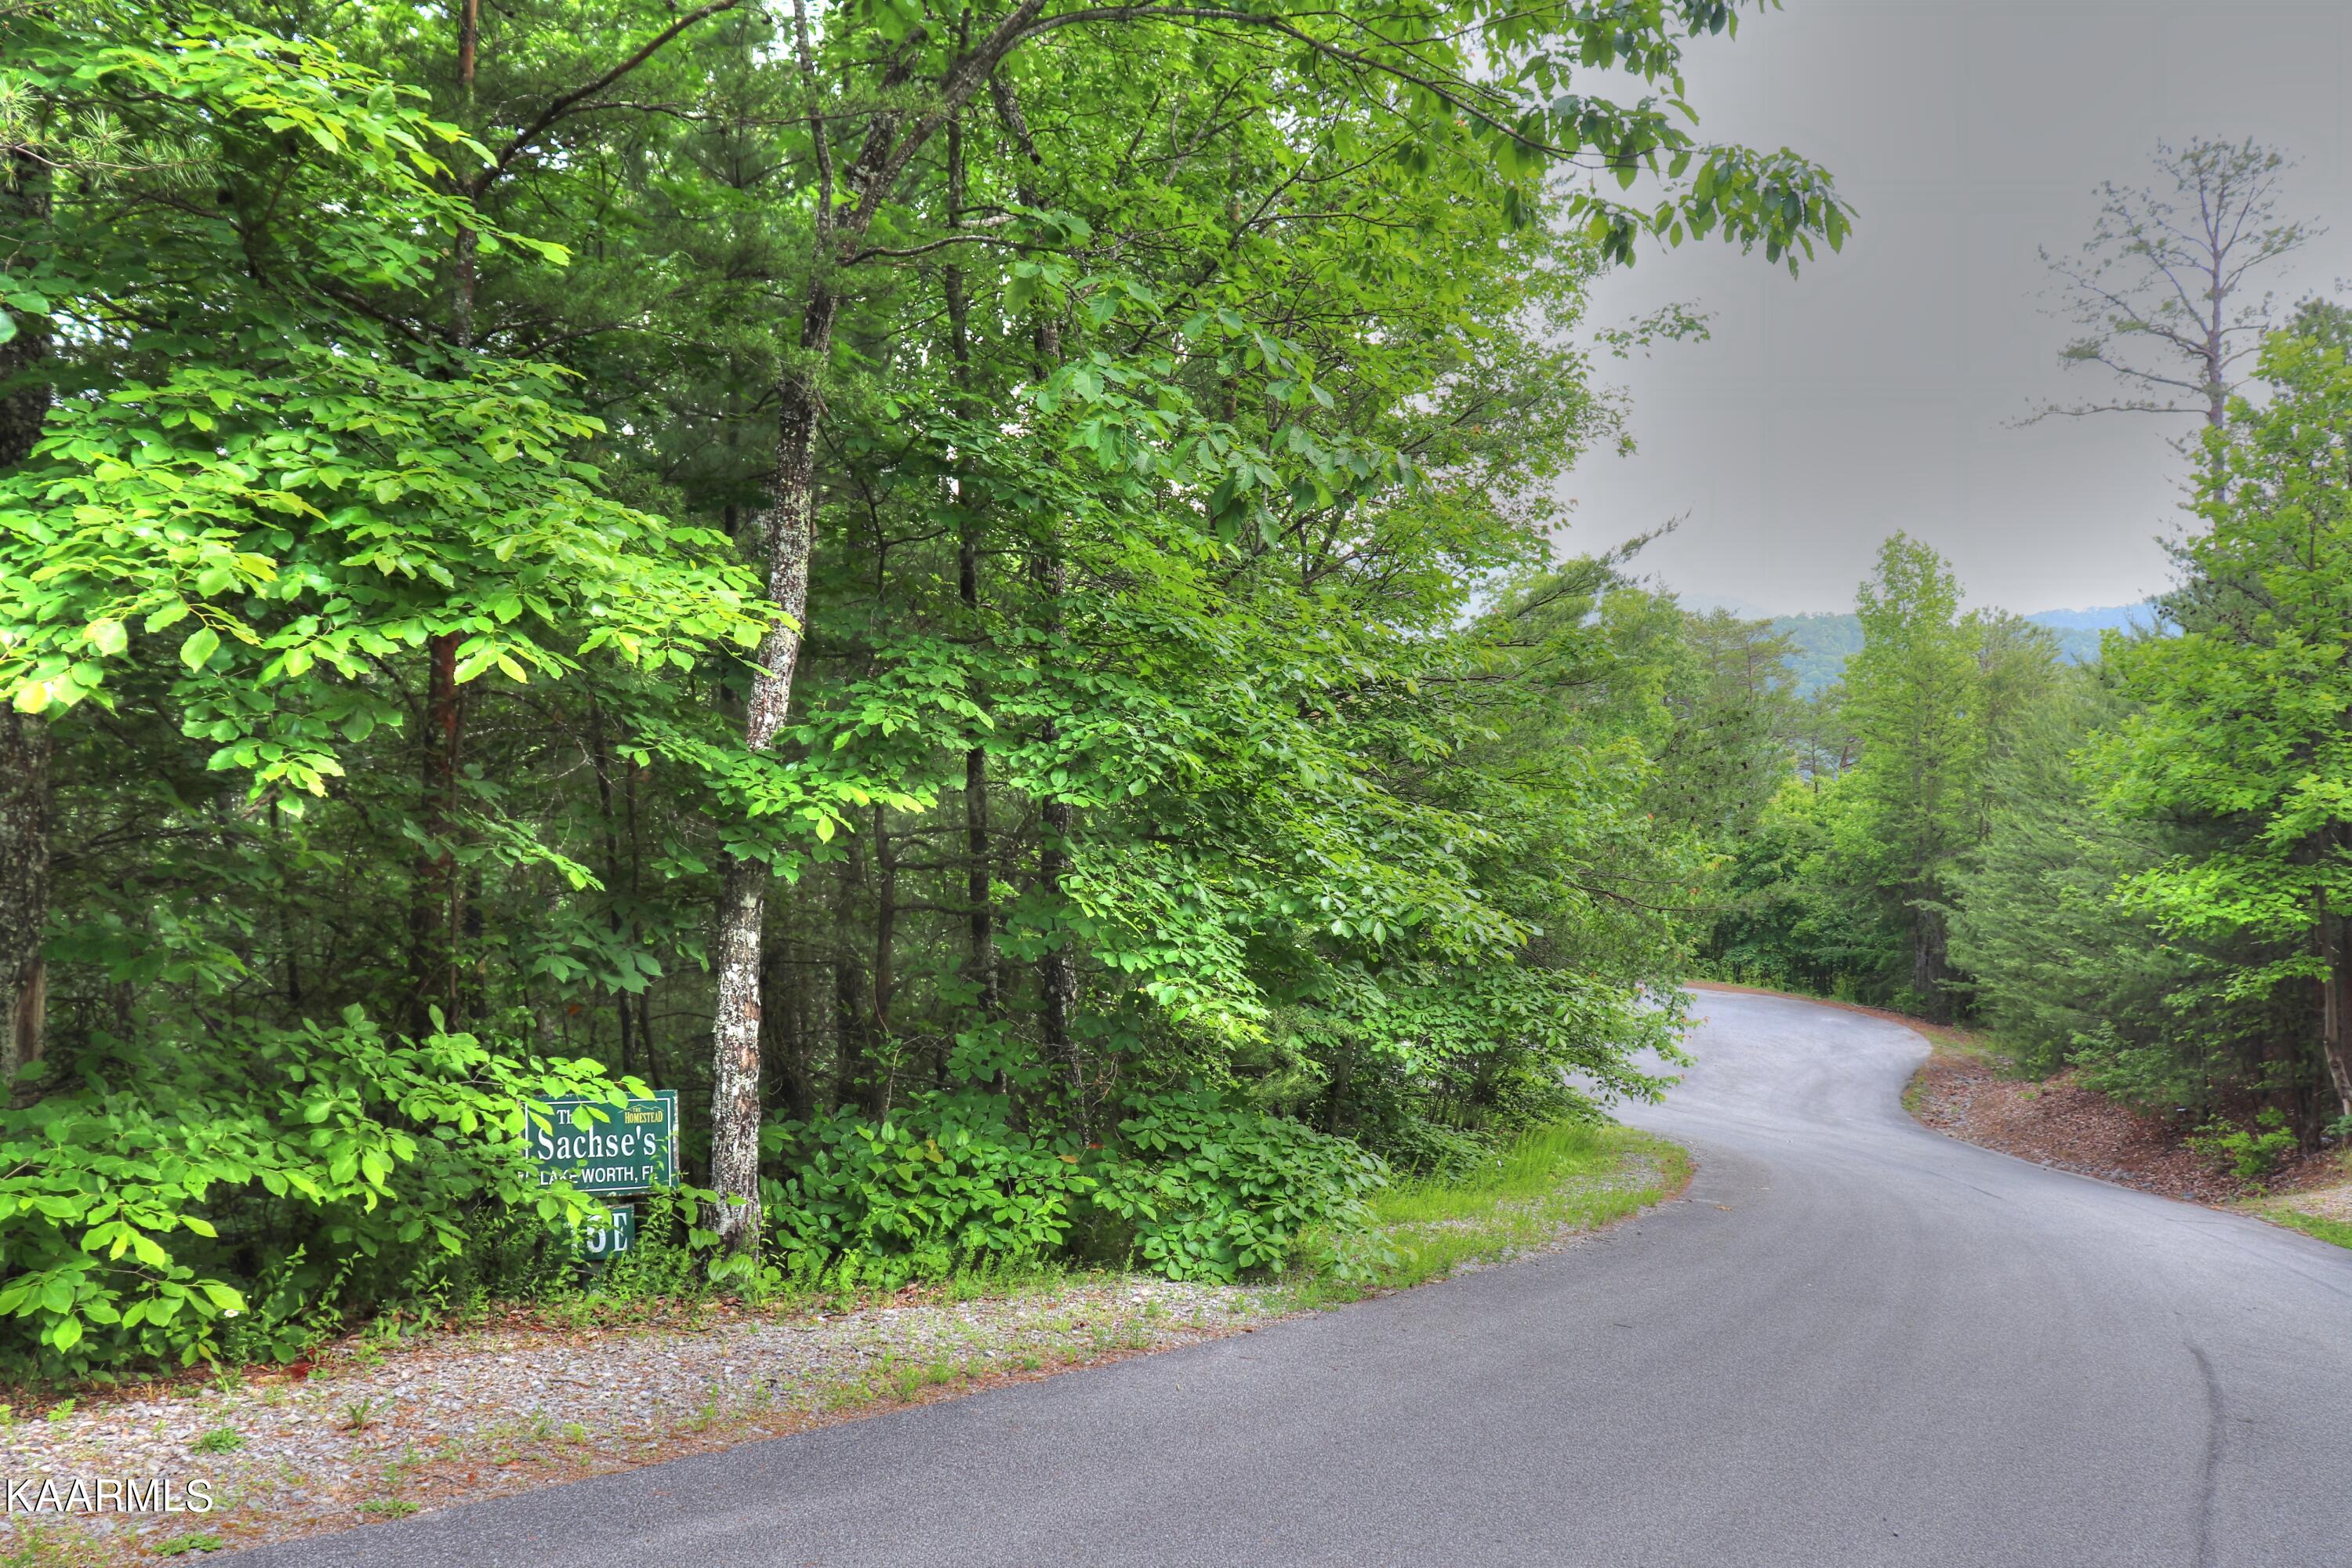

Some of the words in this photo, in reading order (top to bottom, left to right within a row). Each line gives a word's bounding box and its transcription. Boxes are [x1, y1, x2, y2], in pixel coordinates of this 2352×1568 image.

[556, 1109, 579, 1124] Th
[624, 1110, 663, 1123] HOMESTEAD
[537, 1124, 656, 1160] Sachse's
[582, 1165, 638, 1184] WORTH,
